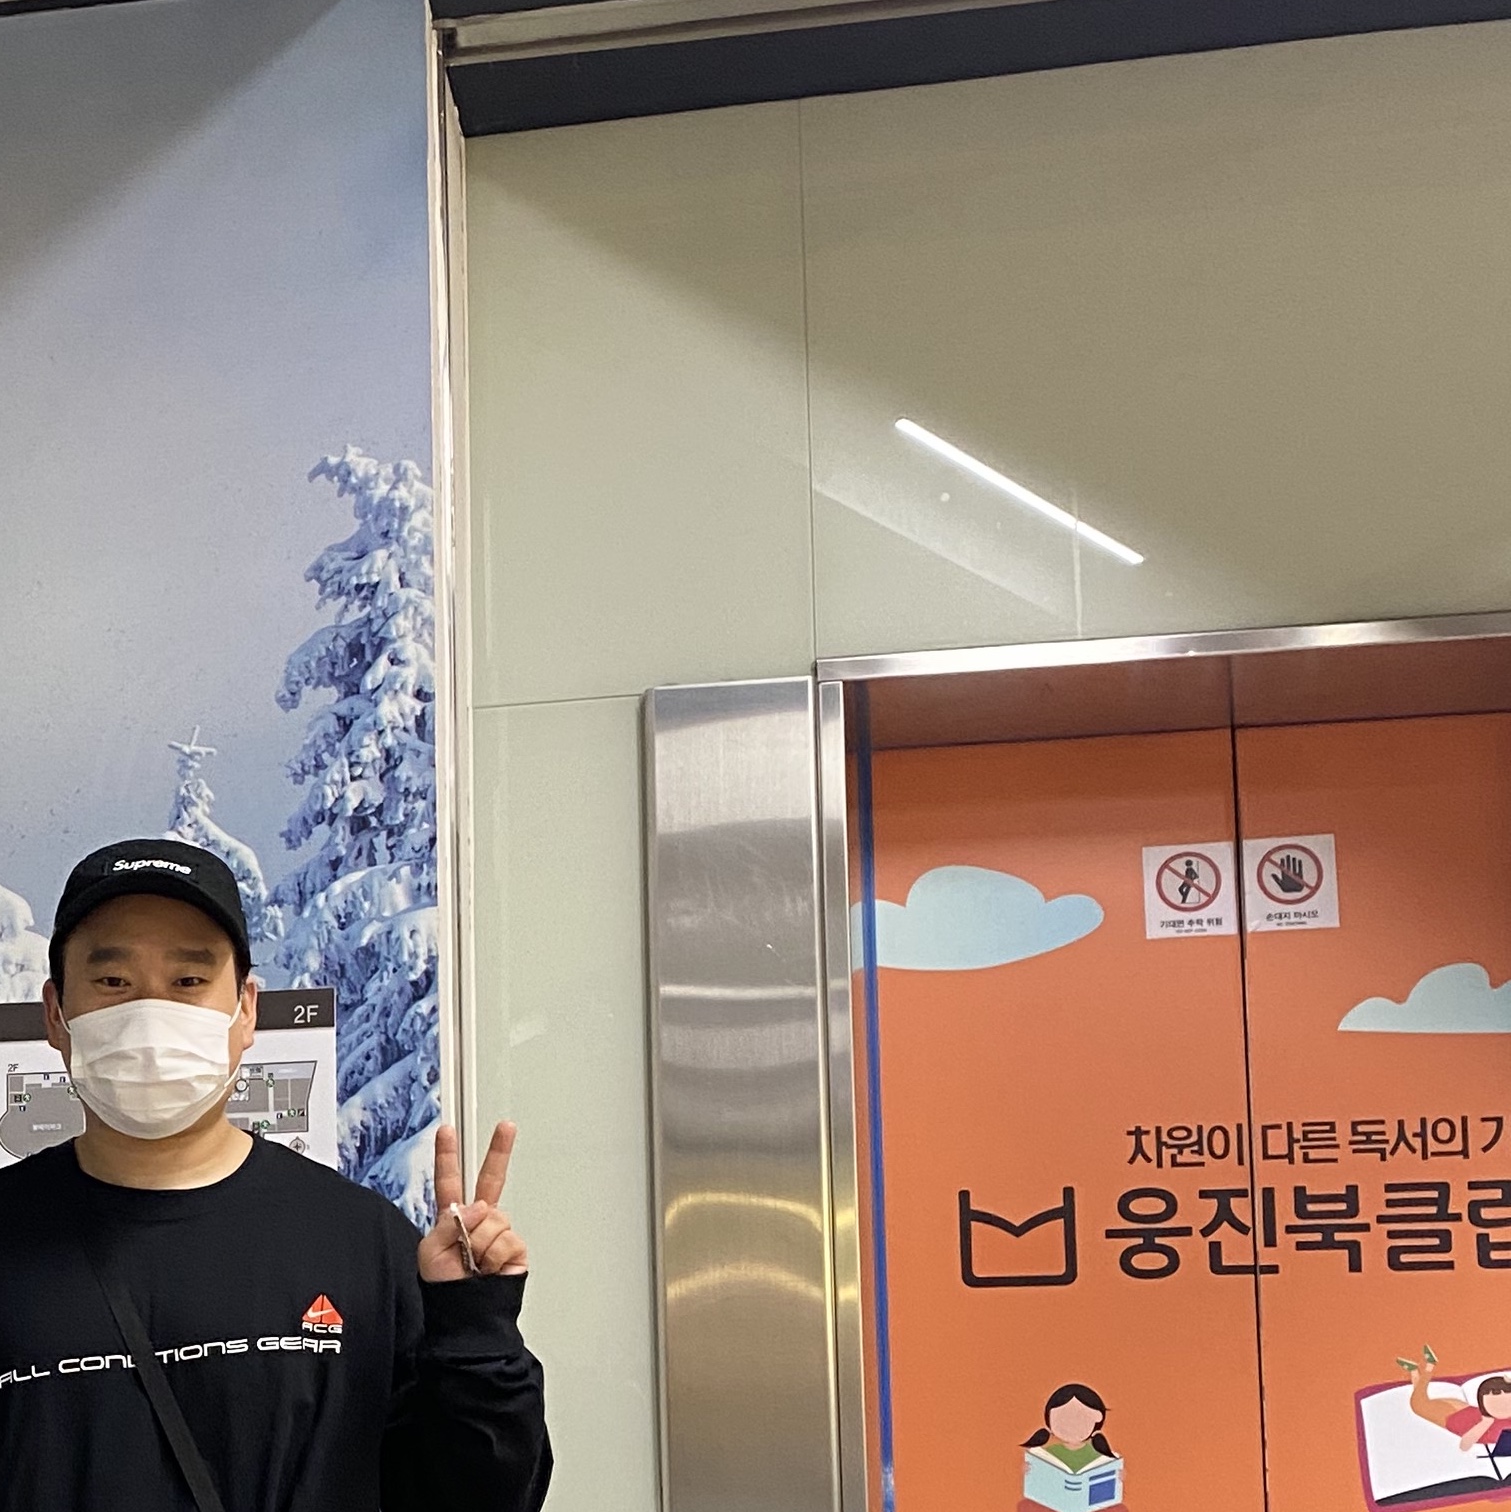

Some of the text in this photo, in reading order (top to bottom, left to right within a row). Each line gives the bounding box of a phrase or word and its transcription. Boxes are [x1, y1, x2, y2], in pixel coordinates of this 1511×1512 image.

[112, 859, 192, 875] Supreme
[1266, 909, 1319, 921] 손대지 마시오
[1160, 919, 1185, 929] 기대면
[293, 1004, 320, 1024] 2F
[7, 1063, 19, 1073] 2F
[1125, 1122, 1245, 1169] 차원이
[1260, 1120, 1341, 1165] 다른
[1347, 1114, 1471, 1163] 독서의
[301, 1321, 343, 1334] ACG
[58, 1338, 249, 1374] CONTIONS
[256, 1336, 342, 1354] GEAR
